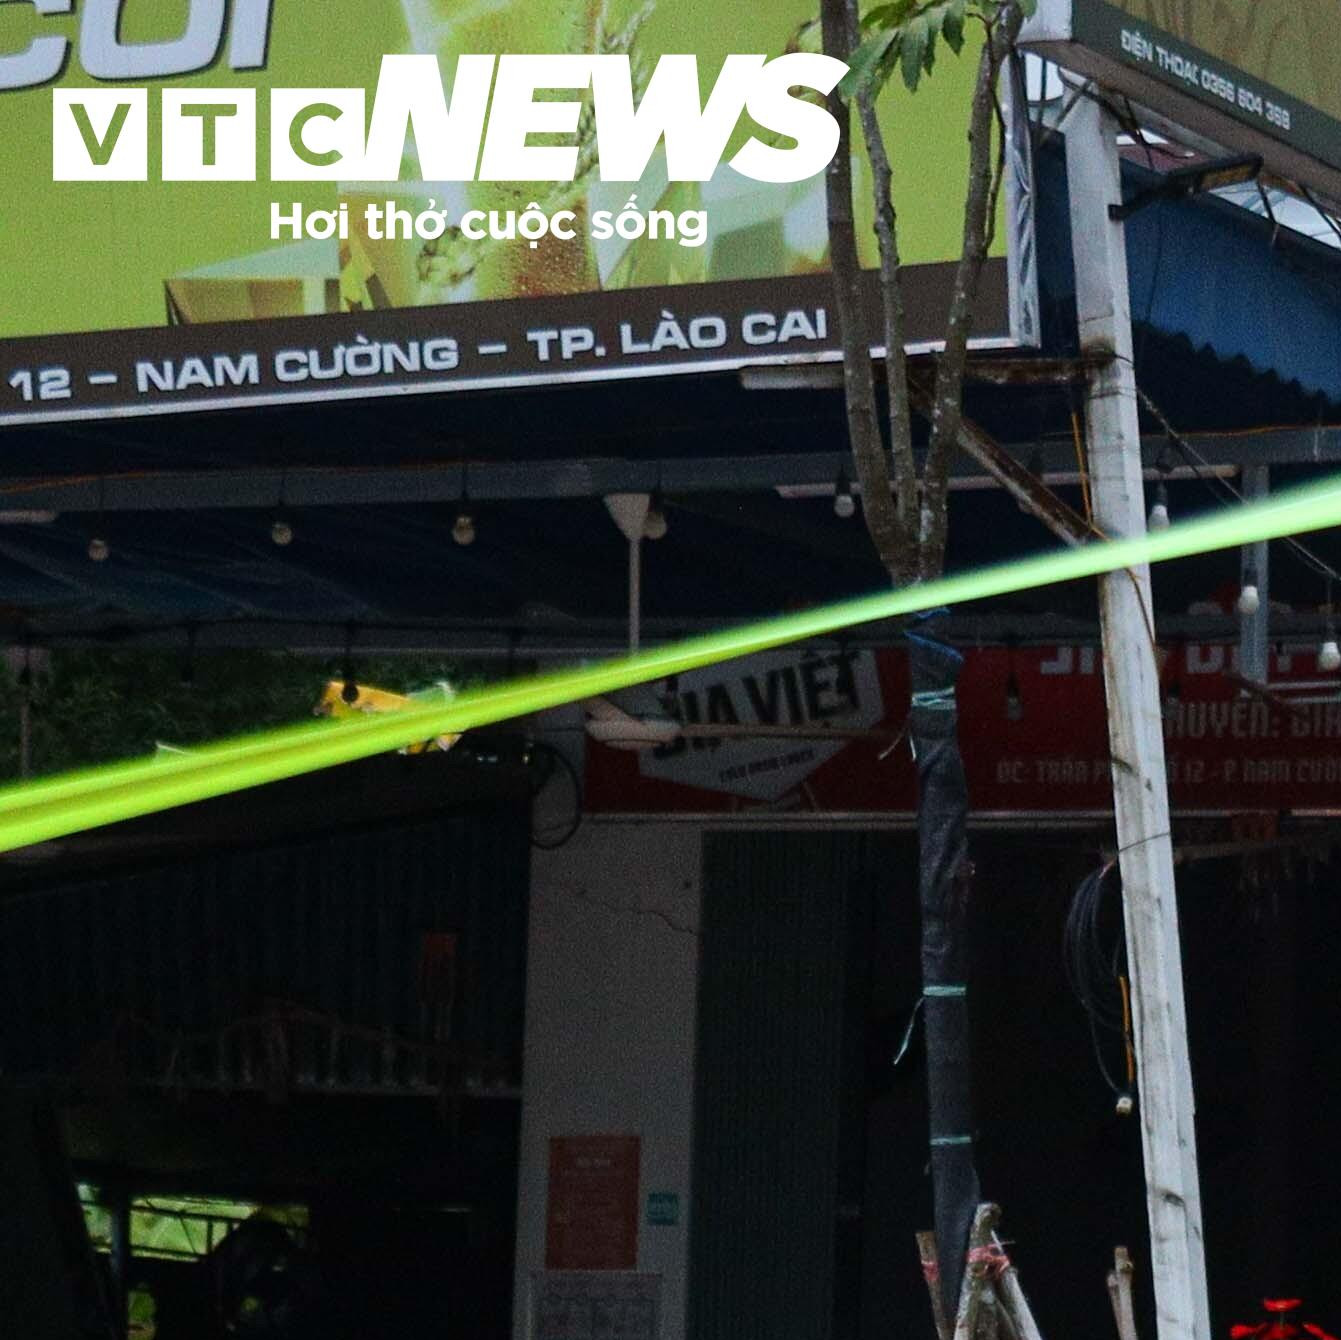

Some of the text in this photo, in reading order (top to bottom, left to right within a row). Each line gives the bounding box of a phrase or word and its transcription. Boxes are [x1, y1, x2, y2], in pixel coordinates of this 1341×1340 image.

[9, 368, 72, 402] 12
[135, 353, 259, 393] NAM
[275, 334, 458, 382] CƯỜNG
[527, 327, 606, 362] TP.
[620, 310, 727, 354] LÀO
[742, 309, 827, 345] CAI
